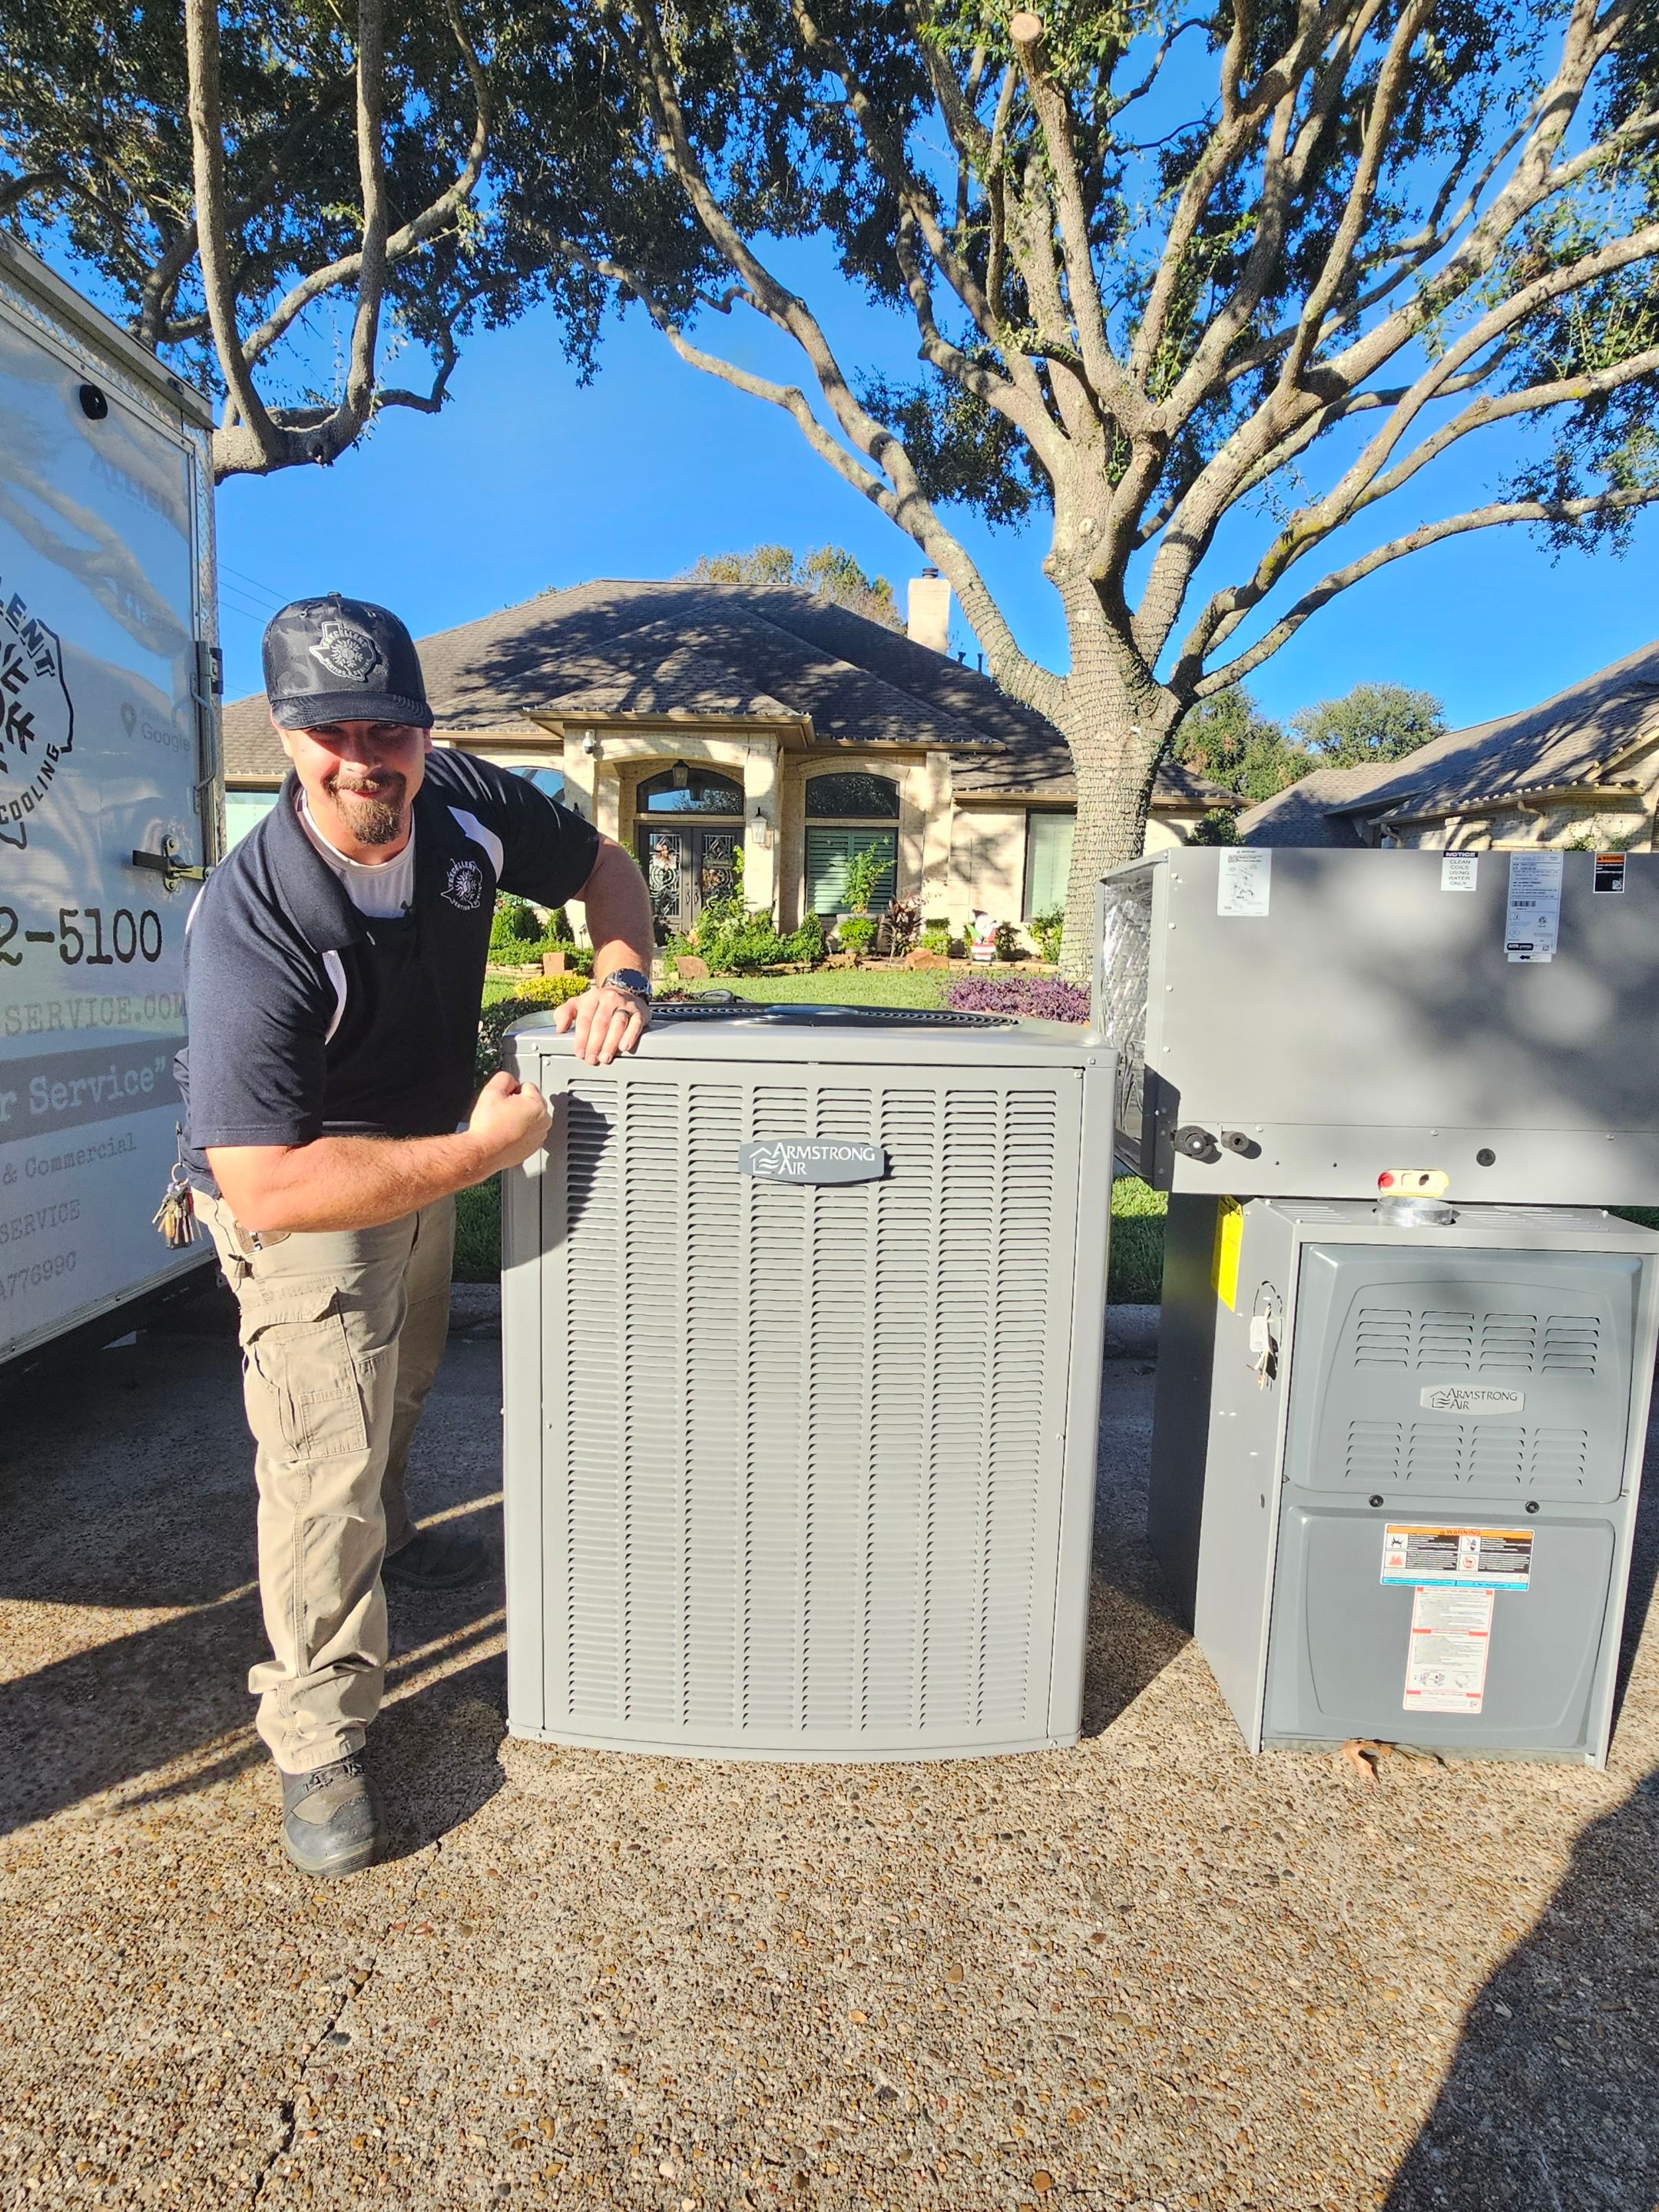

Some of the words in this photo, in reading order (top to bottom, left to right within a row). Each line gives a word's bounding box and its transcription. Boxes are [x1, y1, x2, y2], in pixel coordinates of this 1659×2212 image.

[0, 574, 55, 677] ENT
[141, 722, 190, 753] Google
[0, 743, 60, 825] COOLING
[0, 906, 162, 966] 2-5100
[771, 1142, 876, 1161] ARMSTRONG
[3, 1163, 17, 1185] &
[777, 1158, 808, 1175] AIR
[0, 1198, 80, 1244] SERVICE
[1446, 1388, 1518, 1401] ARMSTRONG
[1450, 1399, 1470, 1410] AIR
